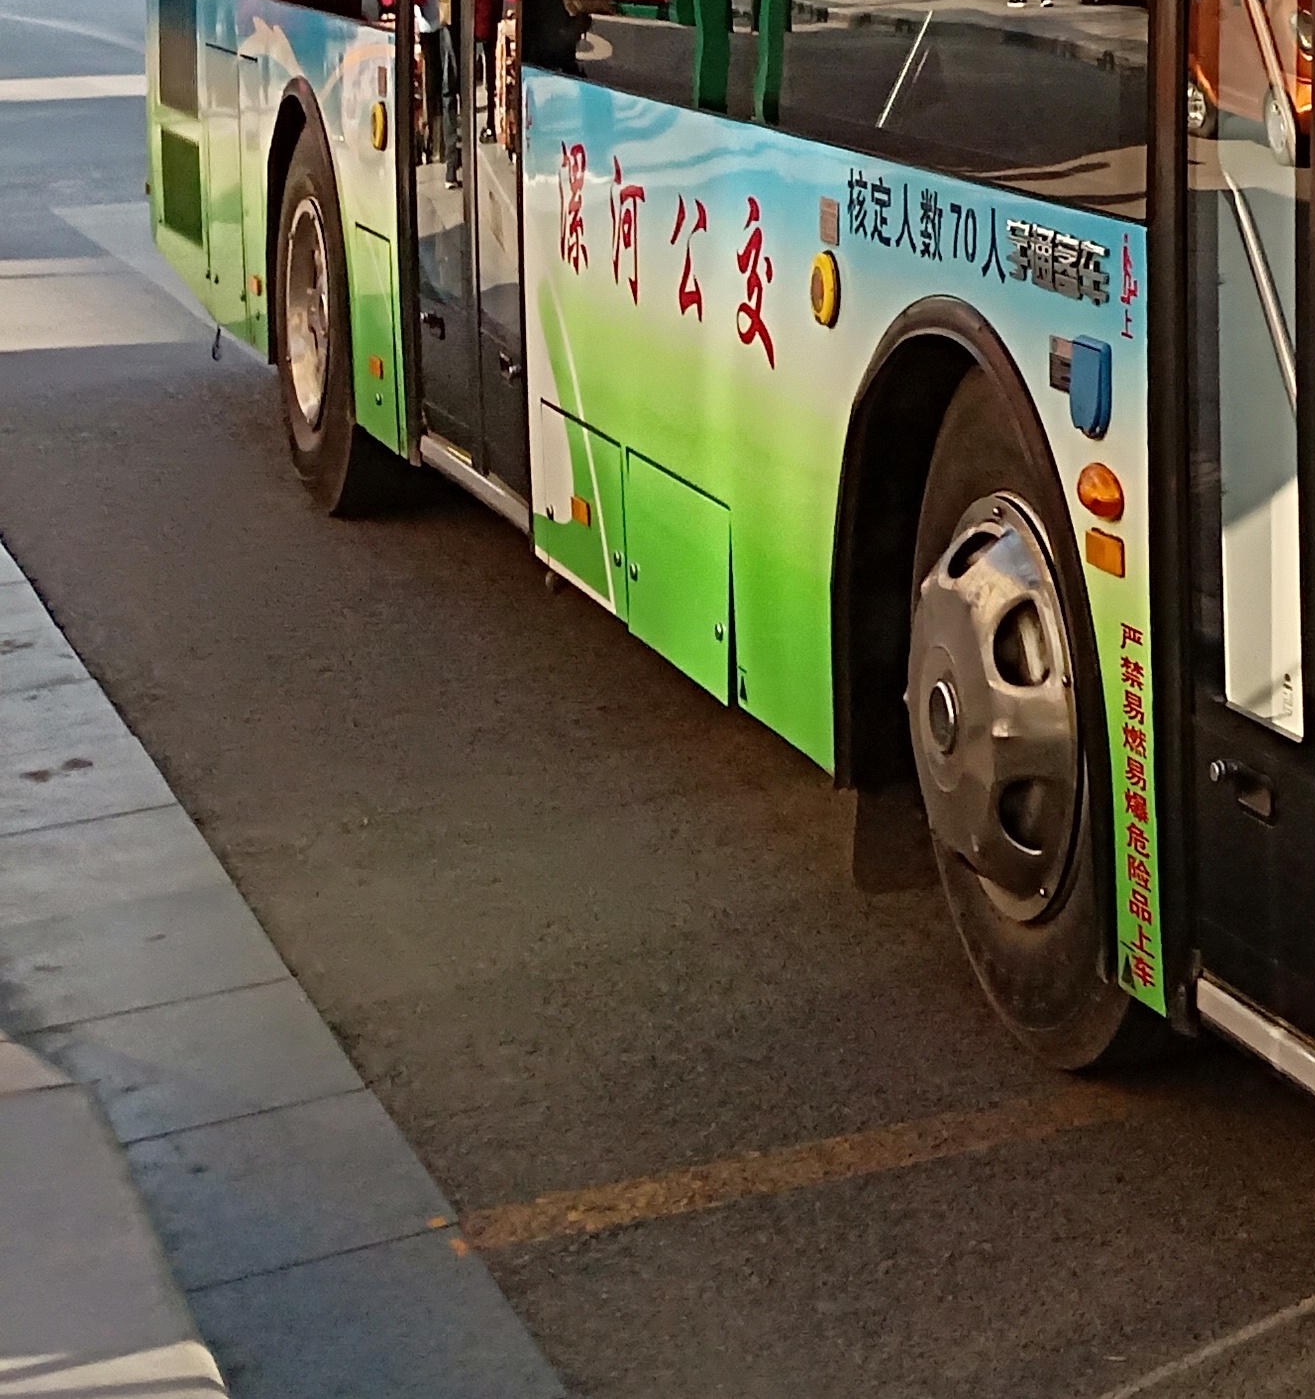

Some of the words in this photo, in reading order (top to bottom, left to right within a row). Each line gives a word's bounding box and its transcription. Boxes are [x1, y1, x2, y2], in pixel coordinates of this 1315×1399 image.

[558, 141, 775, 369] 漯河公交
[847, 167, 1007, 285] 核定人数70人
[1119, 622, 1156, 988] 严禁易燃易爆危险品上车
